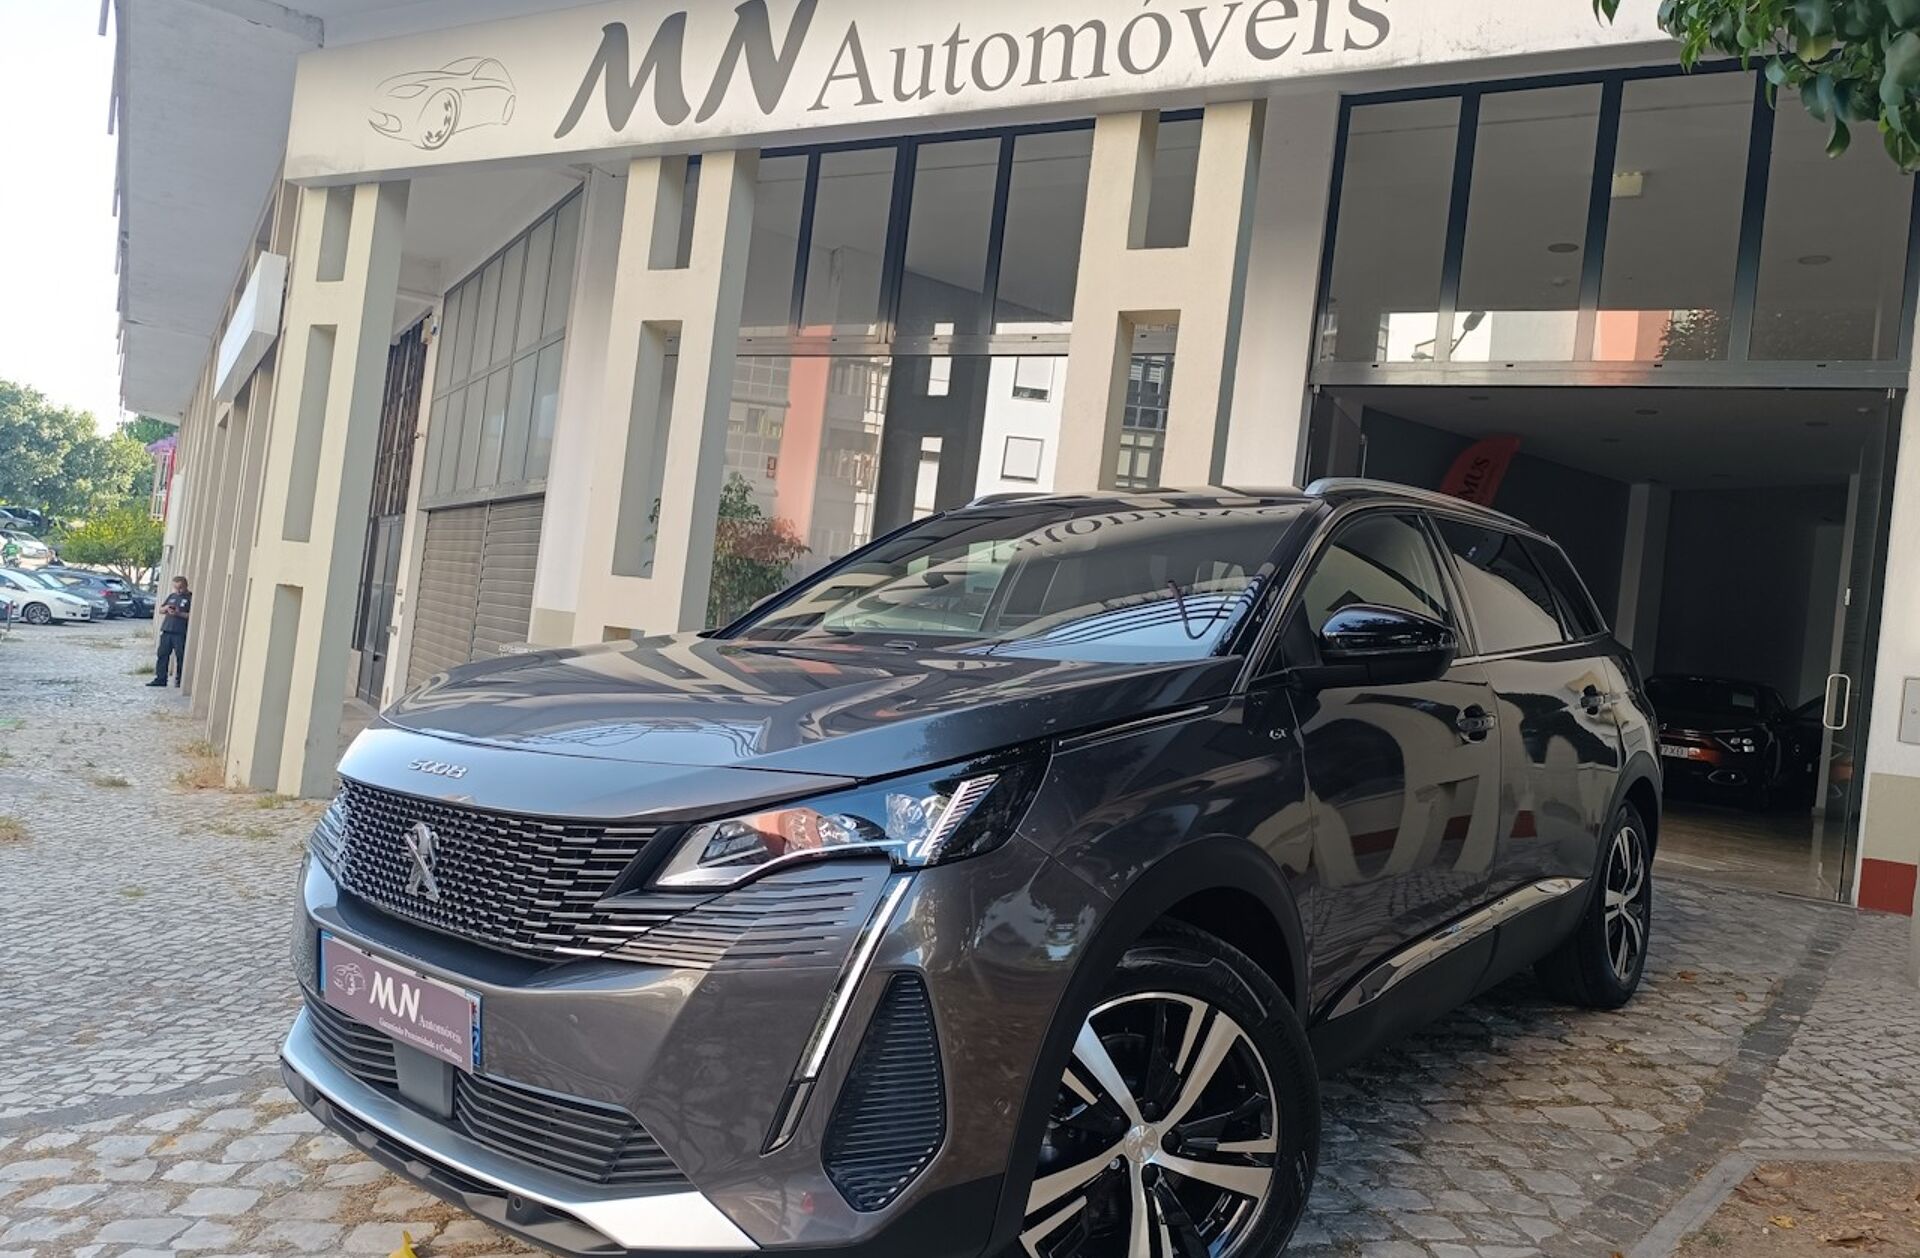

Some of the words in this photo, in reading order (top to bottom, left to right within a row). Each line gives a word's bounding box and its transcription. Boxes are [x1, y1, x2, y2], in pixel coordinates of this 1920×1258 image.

[553, 0, 820, 140] MN
[407, 759, 467, 779] 5008
[368, 970, 421, 1024] MN
